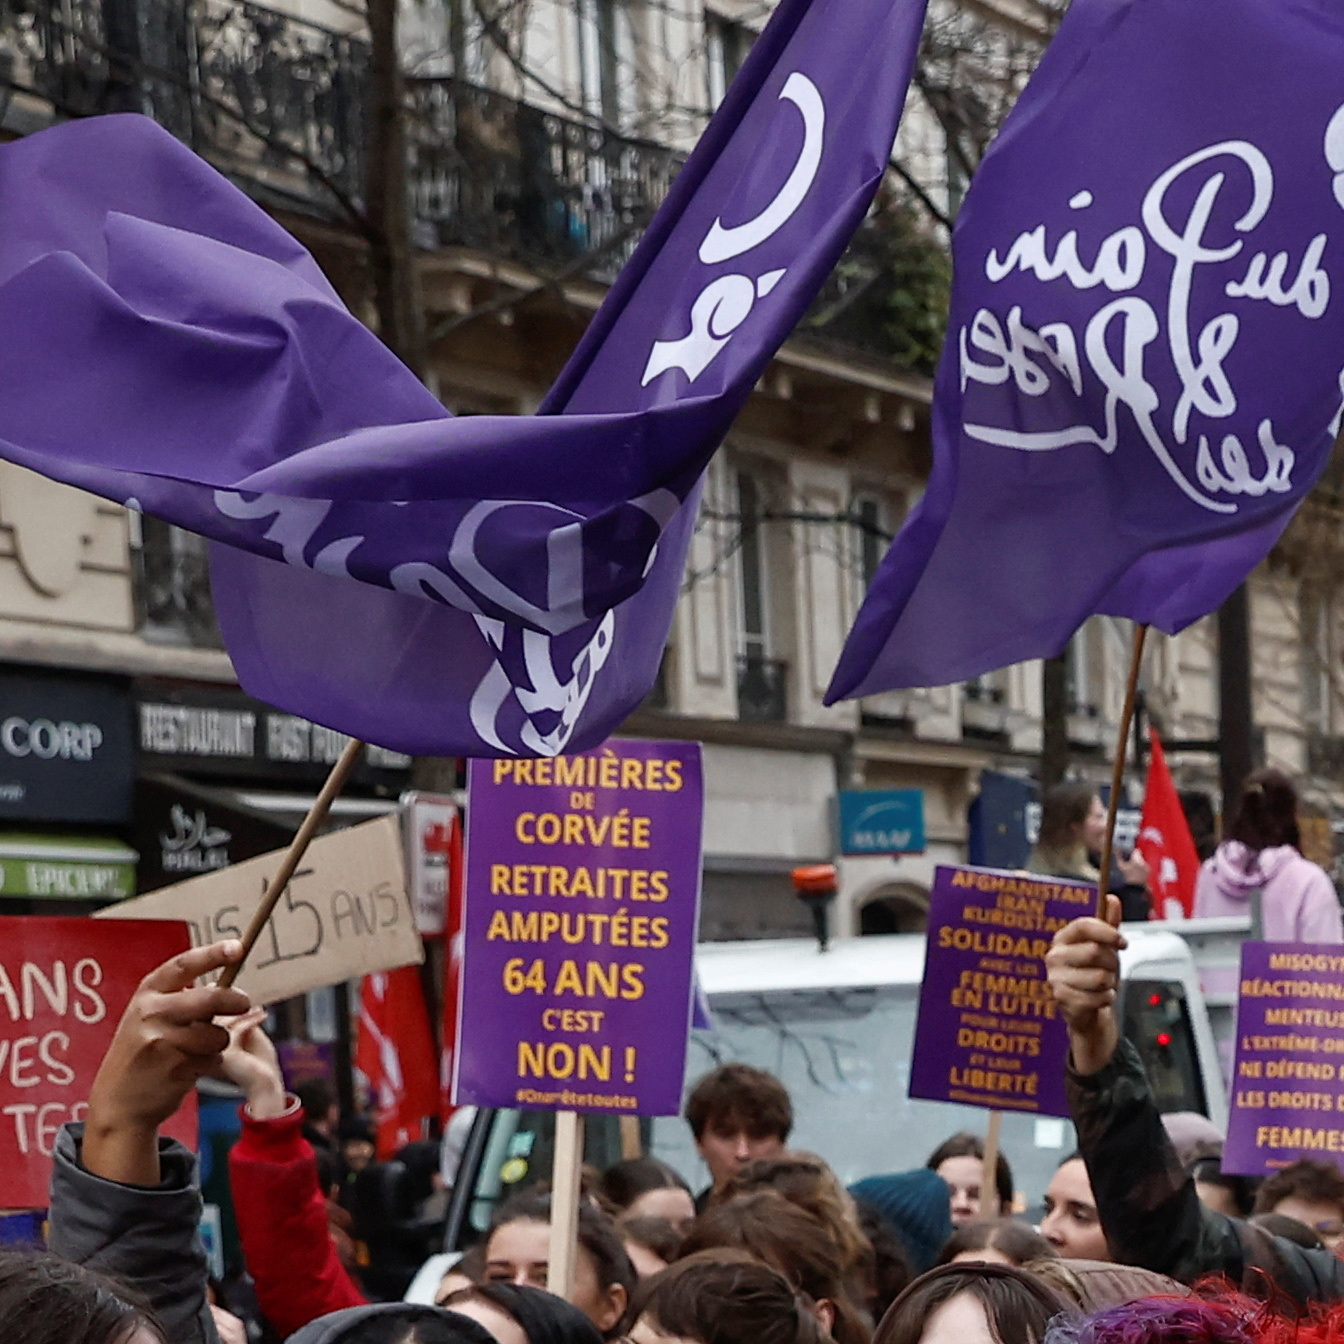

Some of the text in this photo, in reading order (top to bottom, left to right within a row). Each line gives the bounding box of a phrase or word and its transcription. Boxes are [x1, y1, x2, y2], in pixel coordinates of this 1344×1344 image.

[2, 716, 103, 761] CORP
[493, 748, 684, 792] PREMIÈRES
[569, 791, 595, 810] DE
[515, 808, 651, 849] CORVÉE
[489, 863, 670, 903] RETRAITES
[256, 867, 323, 970] 15
[329, 881, 399, 940] ANS
[487, 906, 670, 949] AMPUTÉES
[502, 957, 646, 1000] 64 ANS
[542, 1008, 606, 1033] C'EST
[517, 1040, 637, 1084] NON !
[957, 1027, 1042, 1058] DROITS
[950, 1065, 1039, 1096] LIBERTÉ
[1265, 1057, 1336, 1082] DÉFEND
[1268, 1090, 1334, 1112] DROITS
